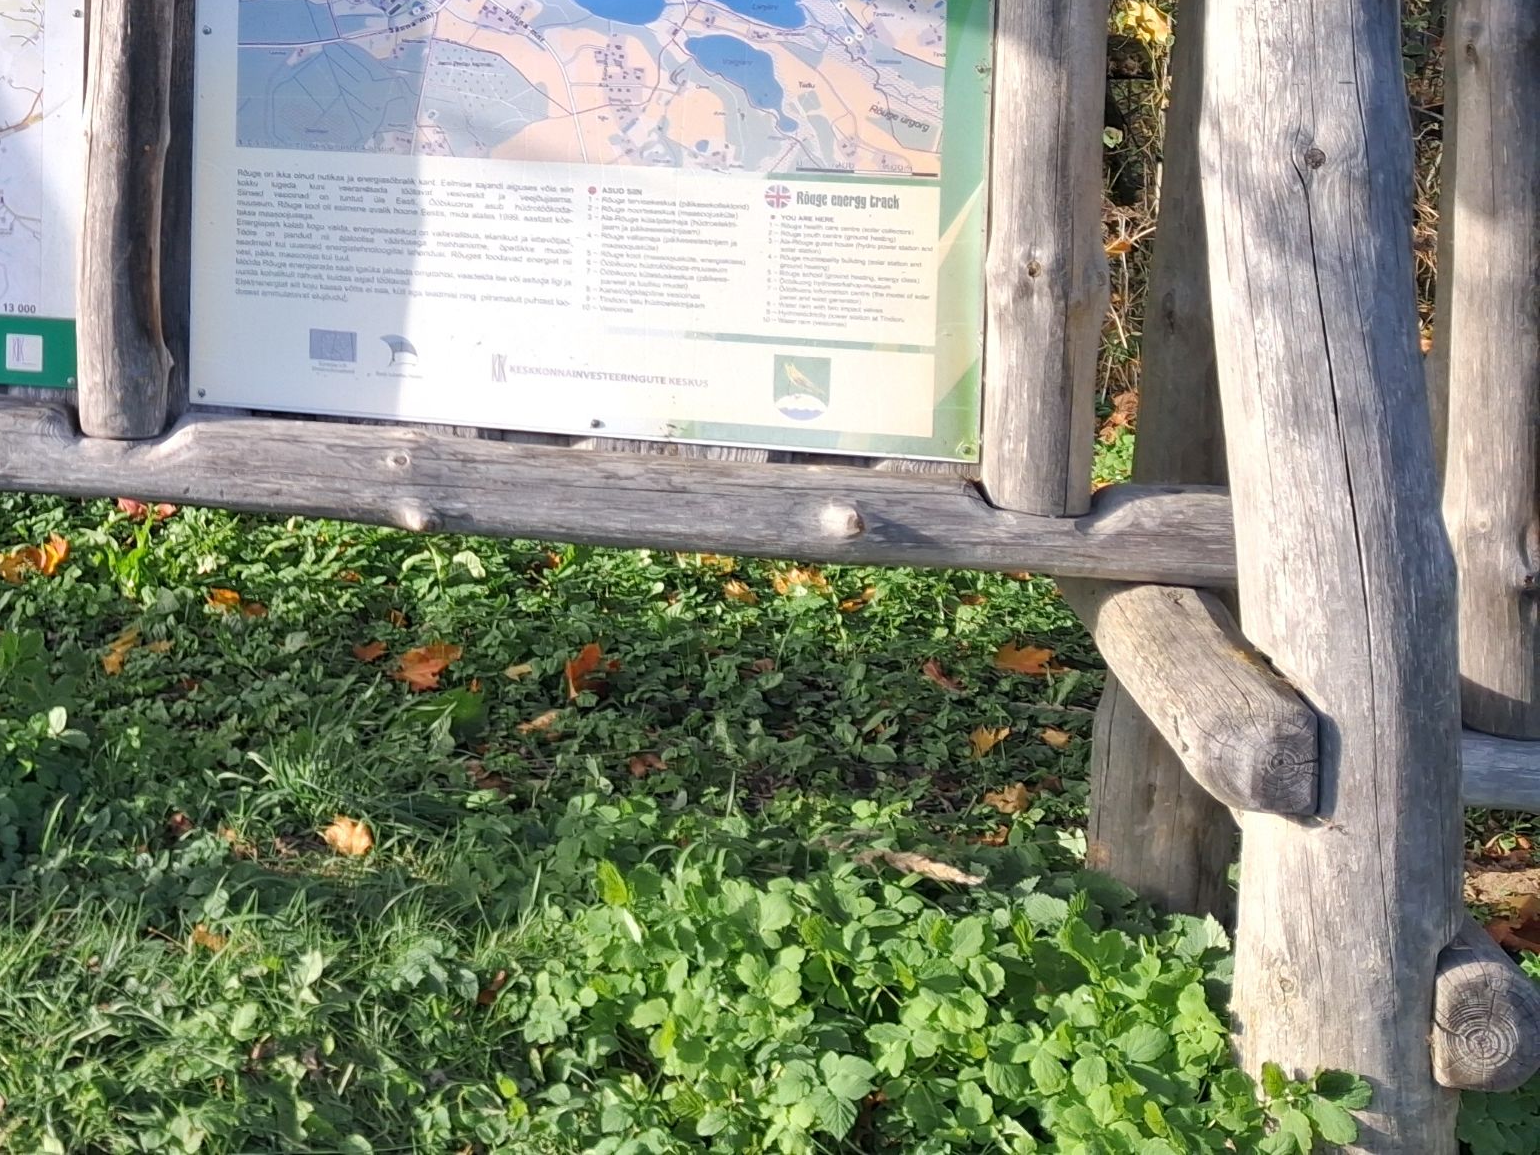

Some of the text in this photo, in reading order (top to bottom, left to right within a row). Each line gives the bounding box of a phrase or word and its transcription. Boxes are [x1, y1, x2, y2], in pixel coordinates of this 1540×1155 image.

[869, 104, 900, 121] Rõuge
[796, 191, 900, 210] Rõuge energy track
[3, 302, 15, 313] 13
[17, 303, 37, 314] 000
[509, 364, 710, 388] KESKKONNAINVESTEERINGUTE KESKUS
